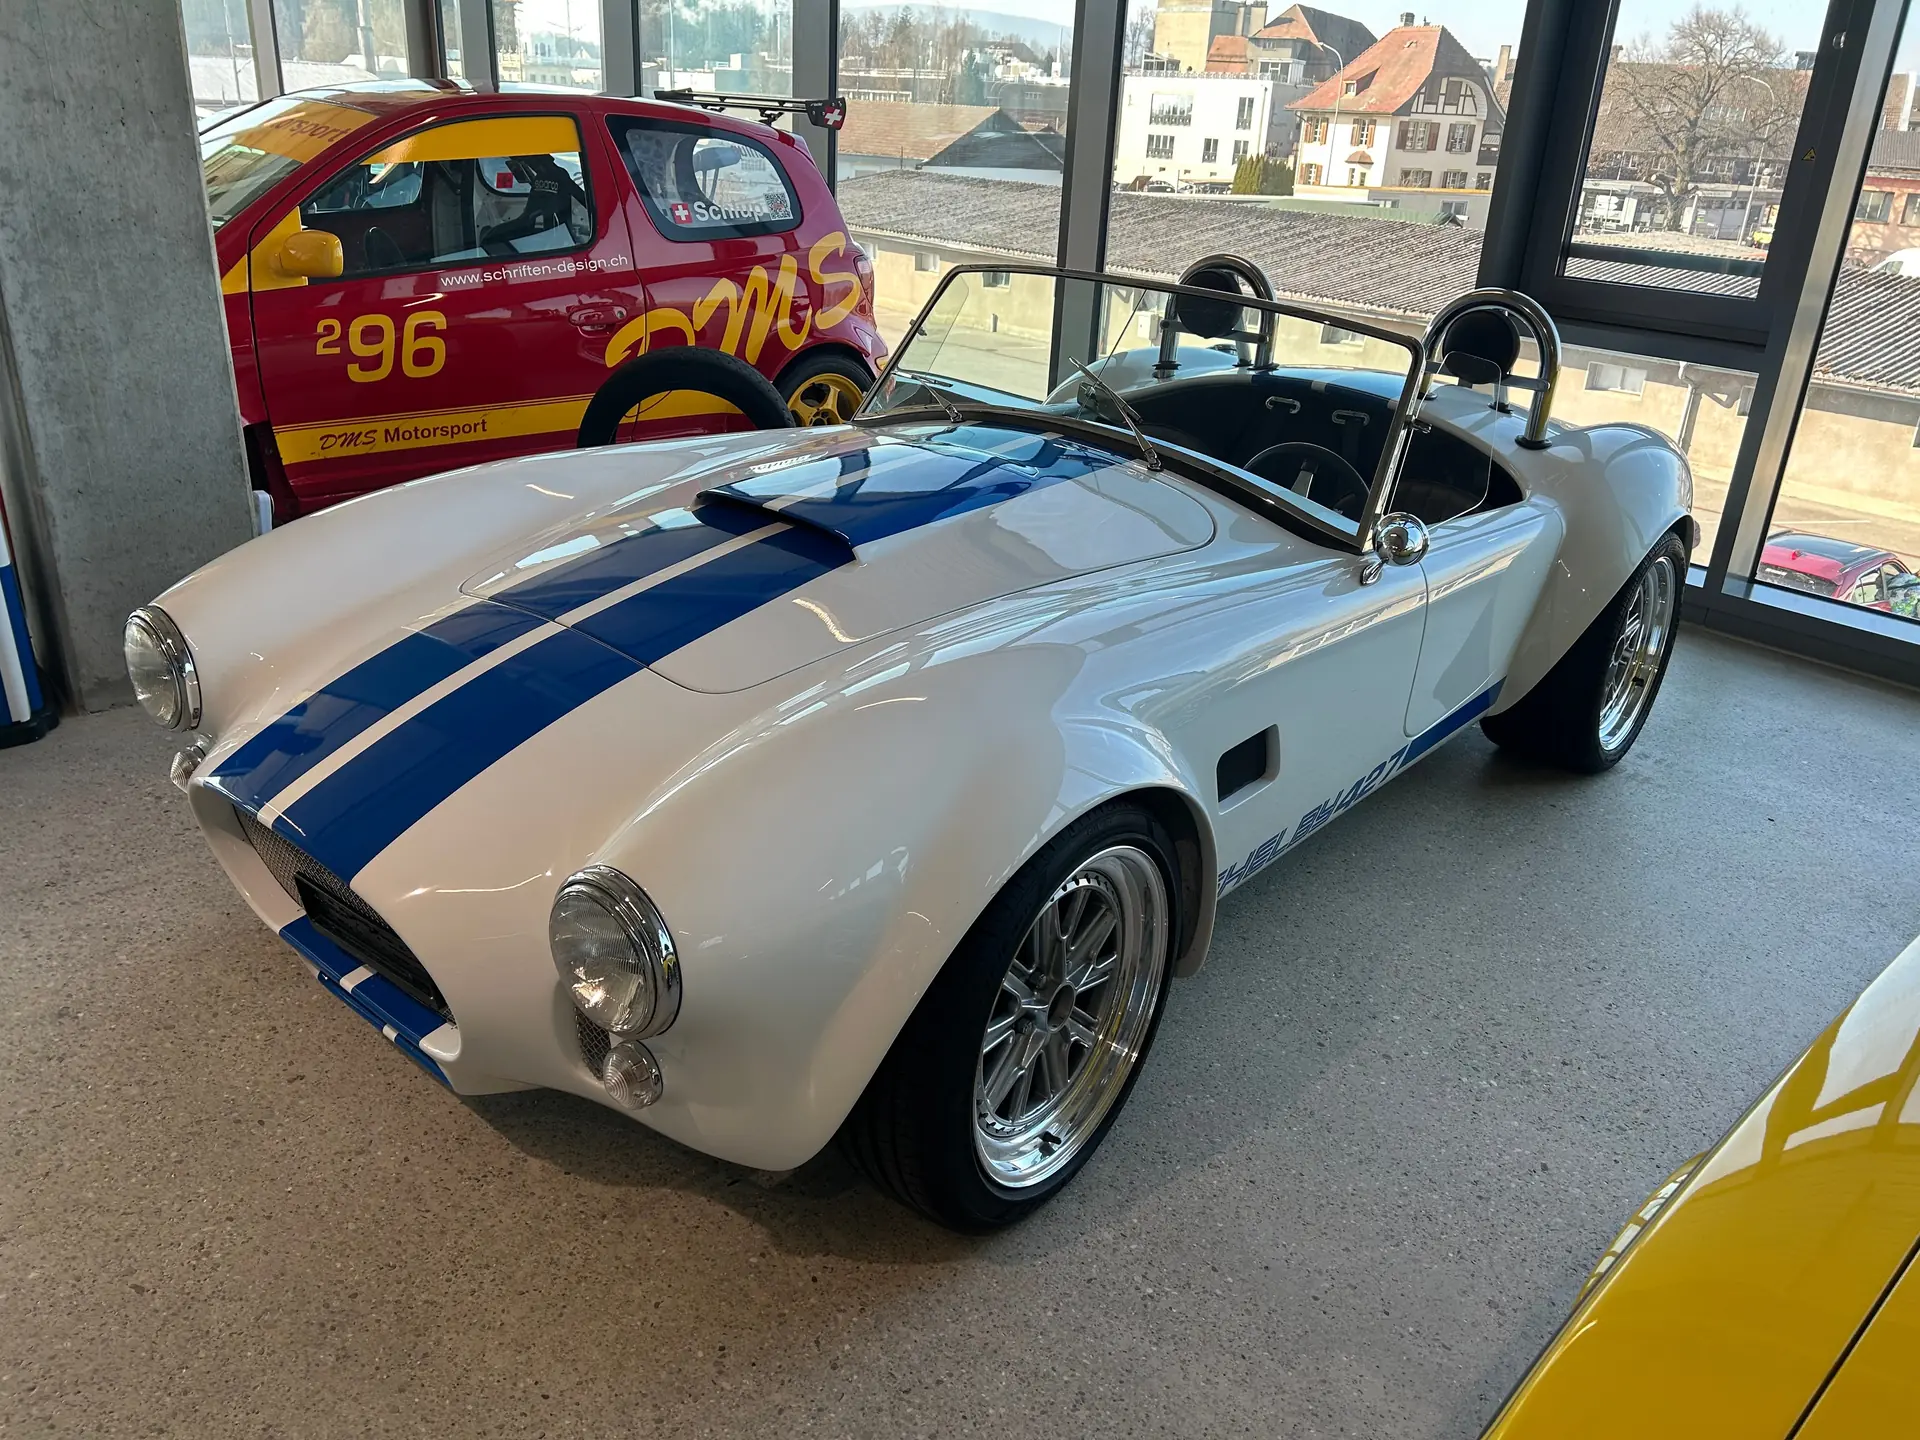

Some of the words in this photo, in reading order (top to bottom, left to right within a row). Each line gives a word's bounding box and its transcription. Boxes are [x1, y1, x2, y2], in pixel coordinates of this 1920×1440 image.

[274, 118, 352, 142] orsport
[440, 254, 628, 287] www.schriften-design.ch
[316, 310, 447, 383] 296
[319, 429, 378, 450] DMS
[384, 418, 488, 443] Motorsport
